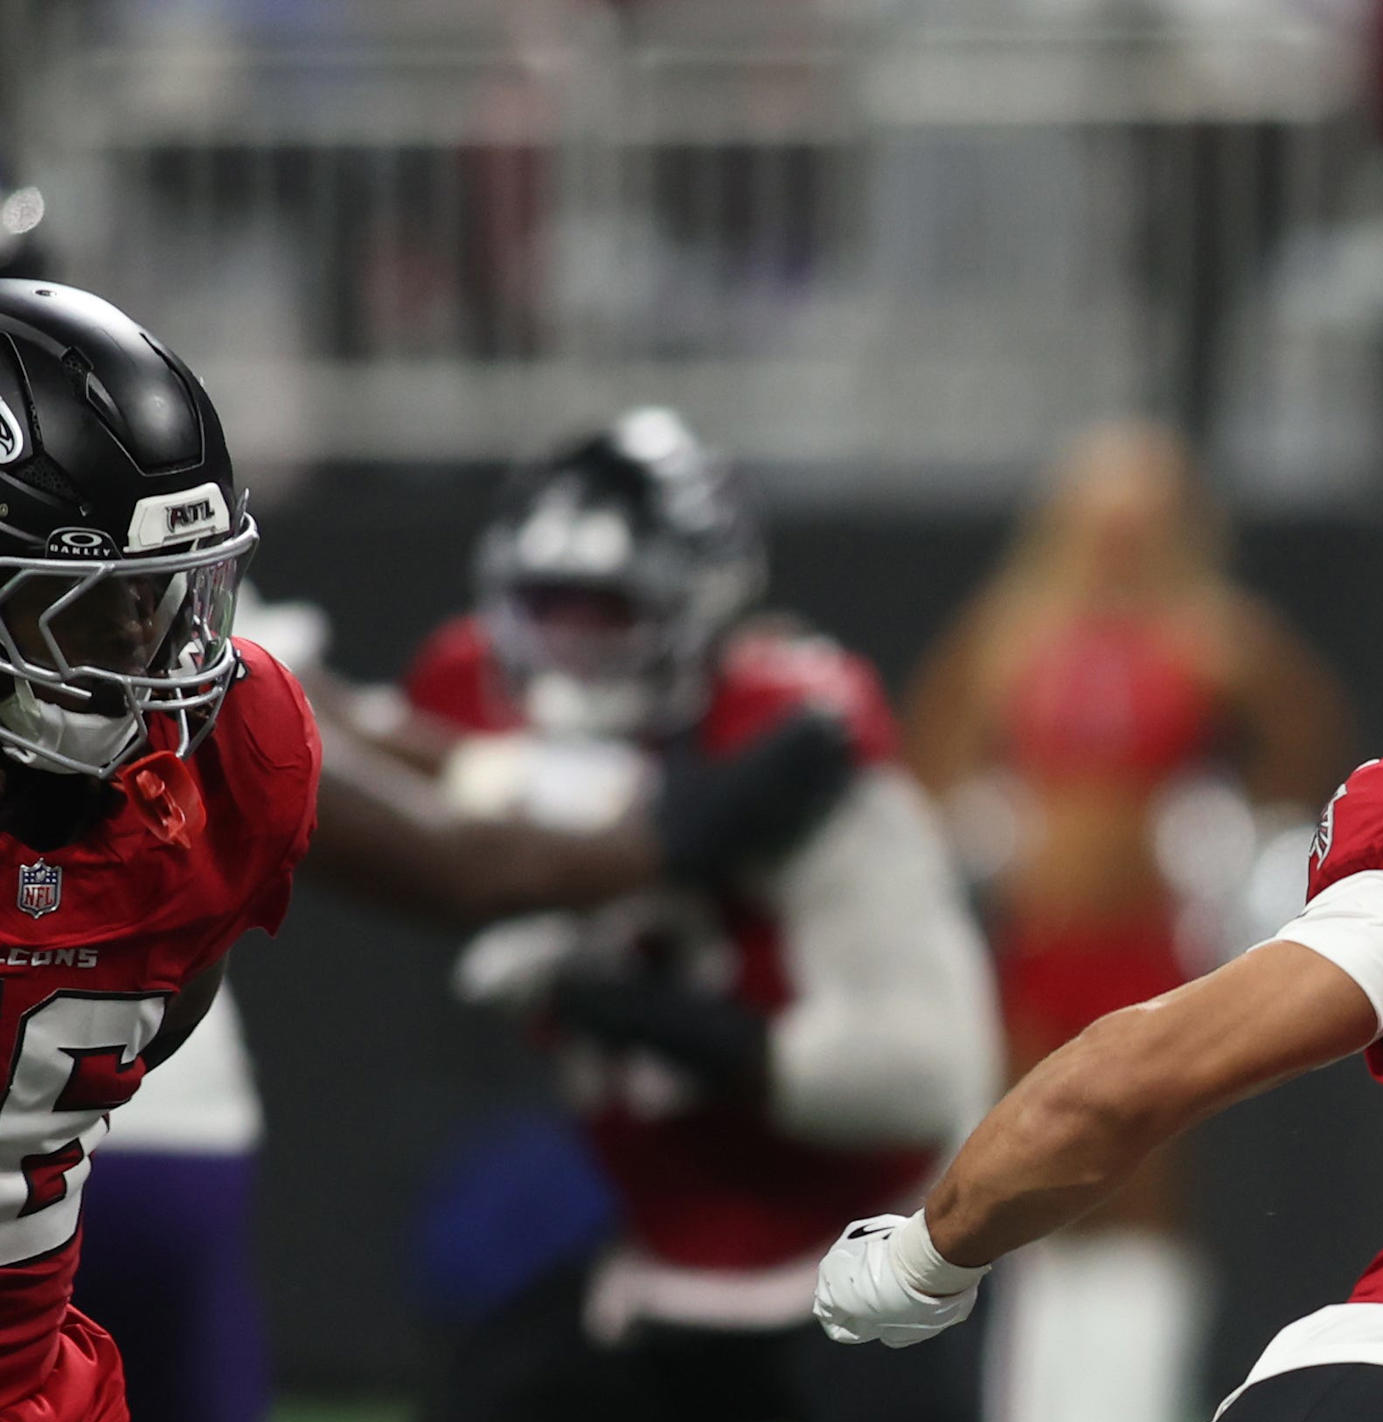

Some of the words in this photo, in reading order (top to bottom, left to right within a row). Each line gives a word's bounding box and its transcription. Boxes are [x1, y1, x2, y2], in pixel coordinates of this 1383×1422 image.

[50, 544, 111, 557] OAKLEY
[24, 886, 54, 907] NFL
[0, 947, 99, 968] CONS
